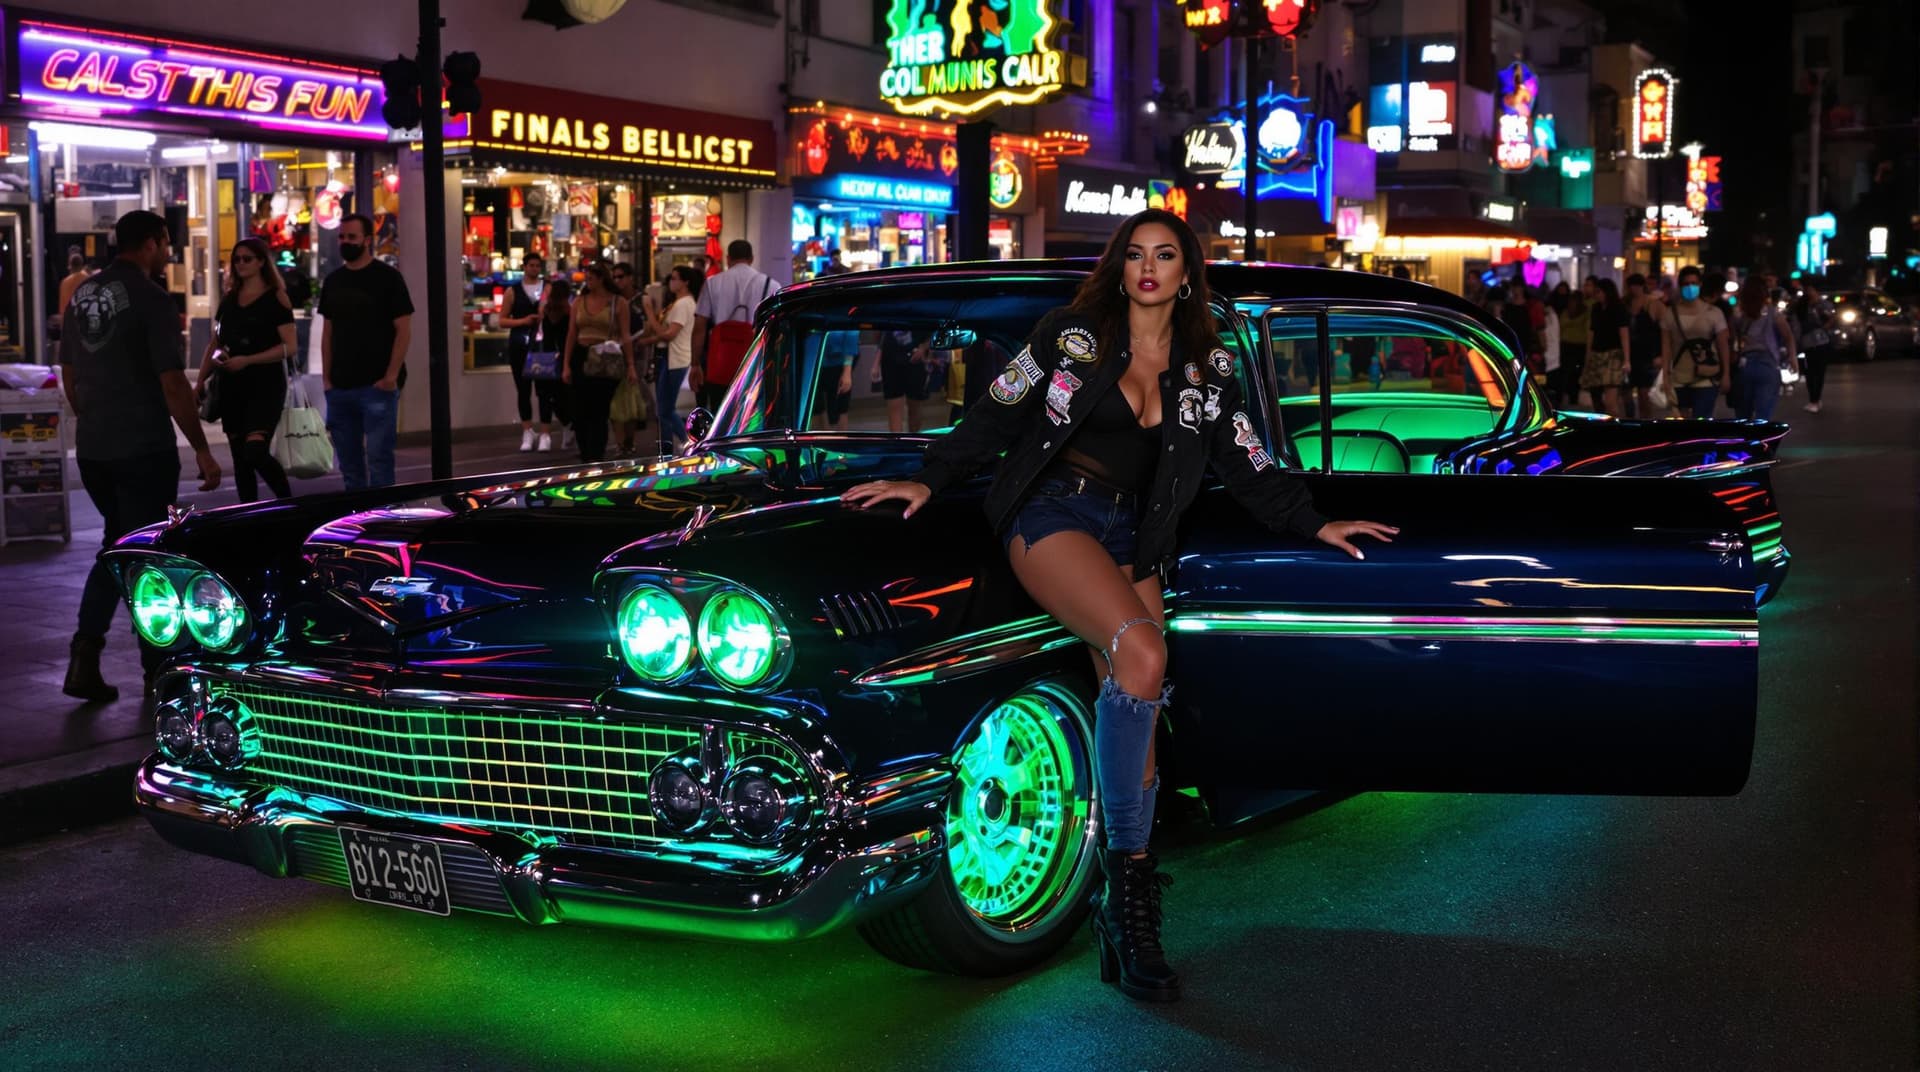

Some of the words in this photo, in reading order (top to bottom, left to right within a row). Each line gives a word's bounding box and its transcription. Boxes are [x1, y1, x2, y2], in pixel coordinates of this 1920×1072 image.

[888, 30, 944, 66] THER
[188, 66, 282, 113] THIS
[285, 81, 371, 123] FUN
[880, 66, 925, 97] COL
[928, 58, 997, 95] MUNIS
[1002, 51, 1060, 87] CALR
[491, 109, 610, 151] FINALS
[622, 126, 753, 166] BELLICST
